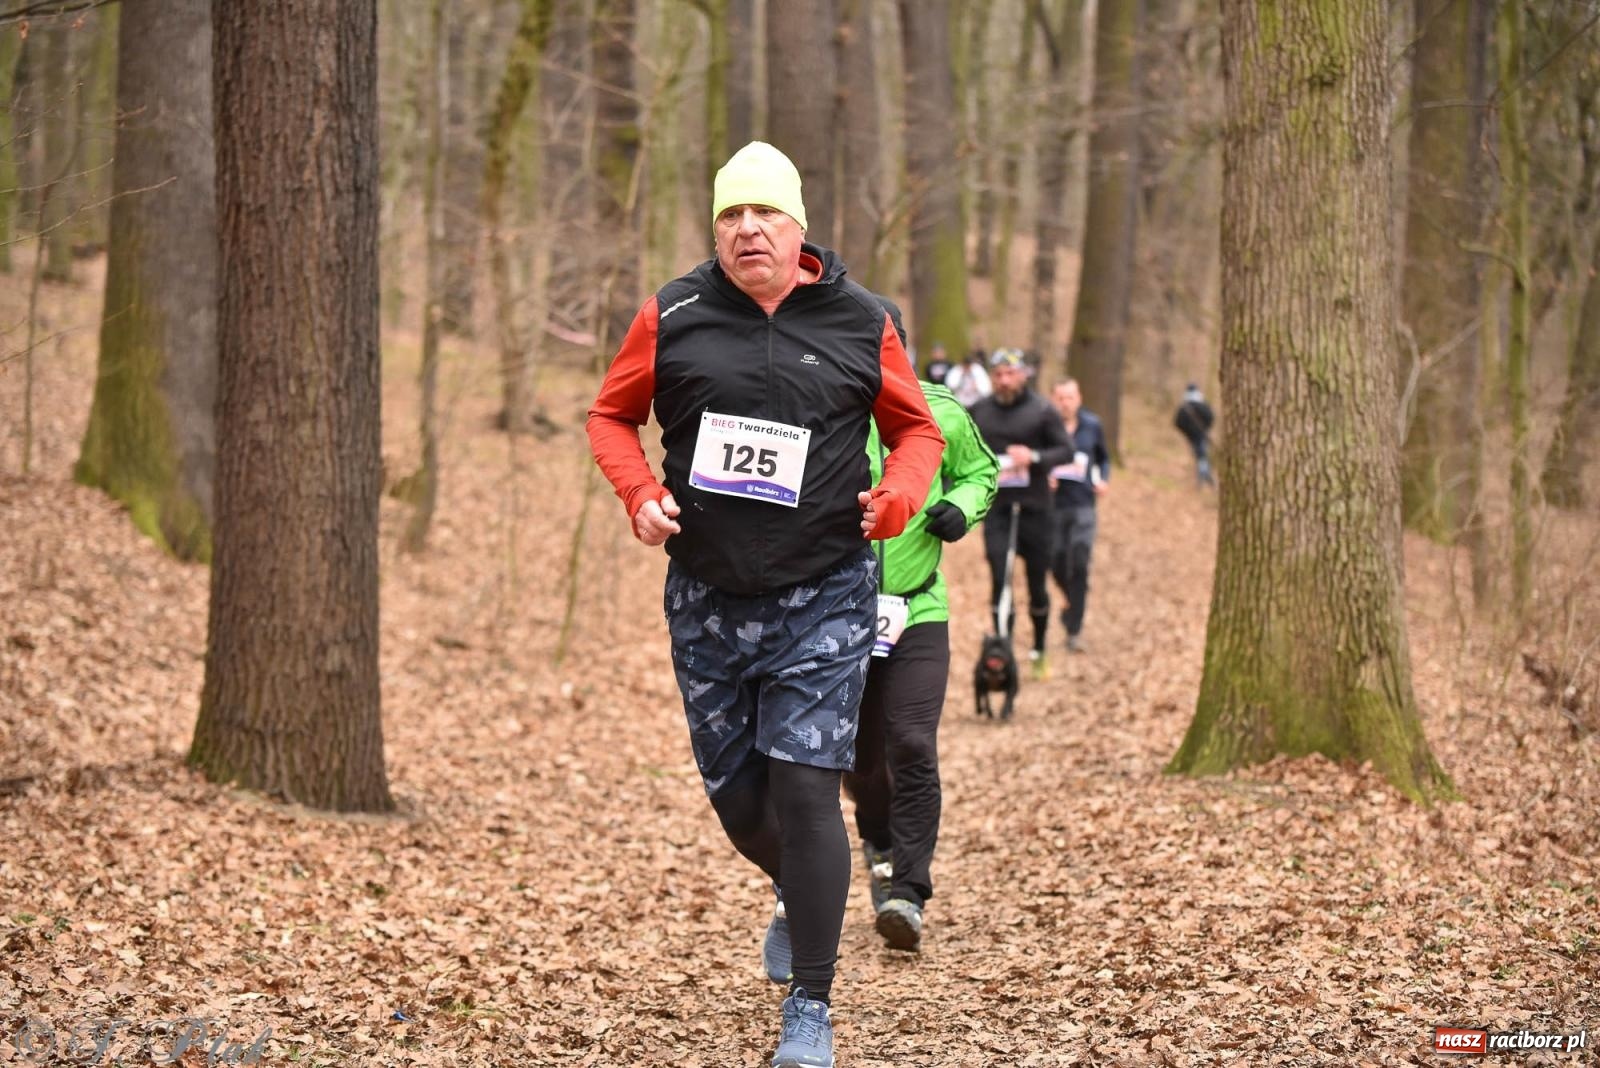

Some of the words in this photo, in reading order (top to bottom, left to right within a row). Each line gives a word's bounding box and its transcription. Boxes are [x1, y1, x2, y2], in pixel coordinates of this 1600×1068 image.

[711, 418, 736, 429] BIEG
[738, 421, 800, 441] Twardziela
[722, 443, 778, 478] 125
